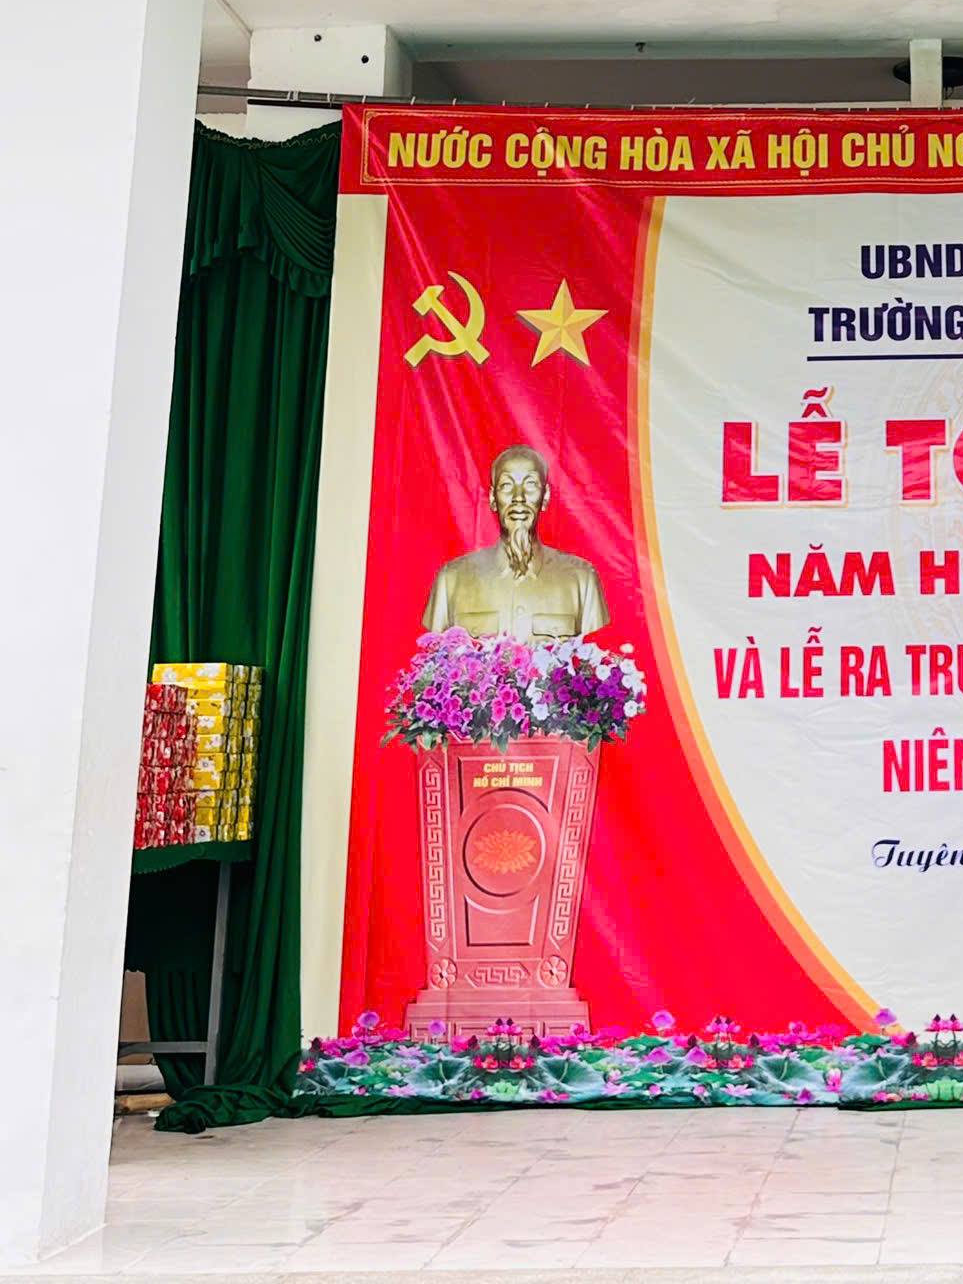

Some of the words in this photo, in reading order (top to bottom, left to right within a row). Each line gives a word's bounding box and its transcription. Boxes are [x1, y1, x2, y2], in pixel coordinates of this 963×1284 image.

[389, 127, 491, 168] NƯỚC
[506, 128, 606, 175] CỘNG
[621, 129, 693, 171] HÒA
[706, 130, 755, 169] XÃ
[768, 129, 827, 175] HỘI
[843, 125, 914, 167] CHỦ
[722, 387, 843, 502] LỄ
[749, 543, 895, 598] NĂM
[714, 635, 765, 698] VÀ
[781, 627, 824, 697] LỄ
[841, 646, 891, 696] RA
